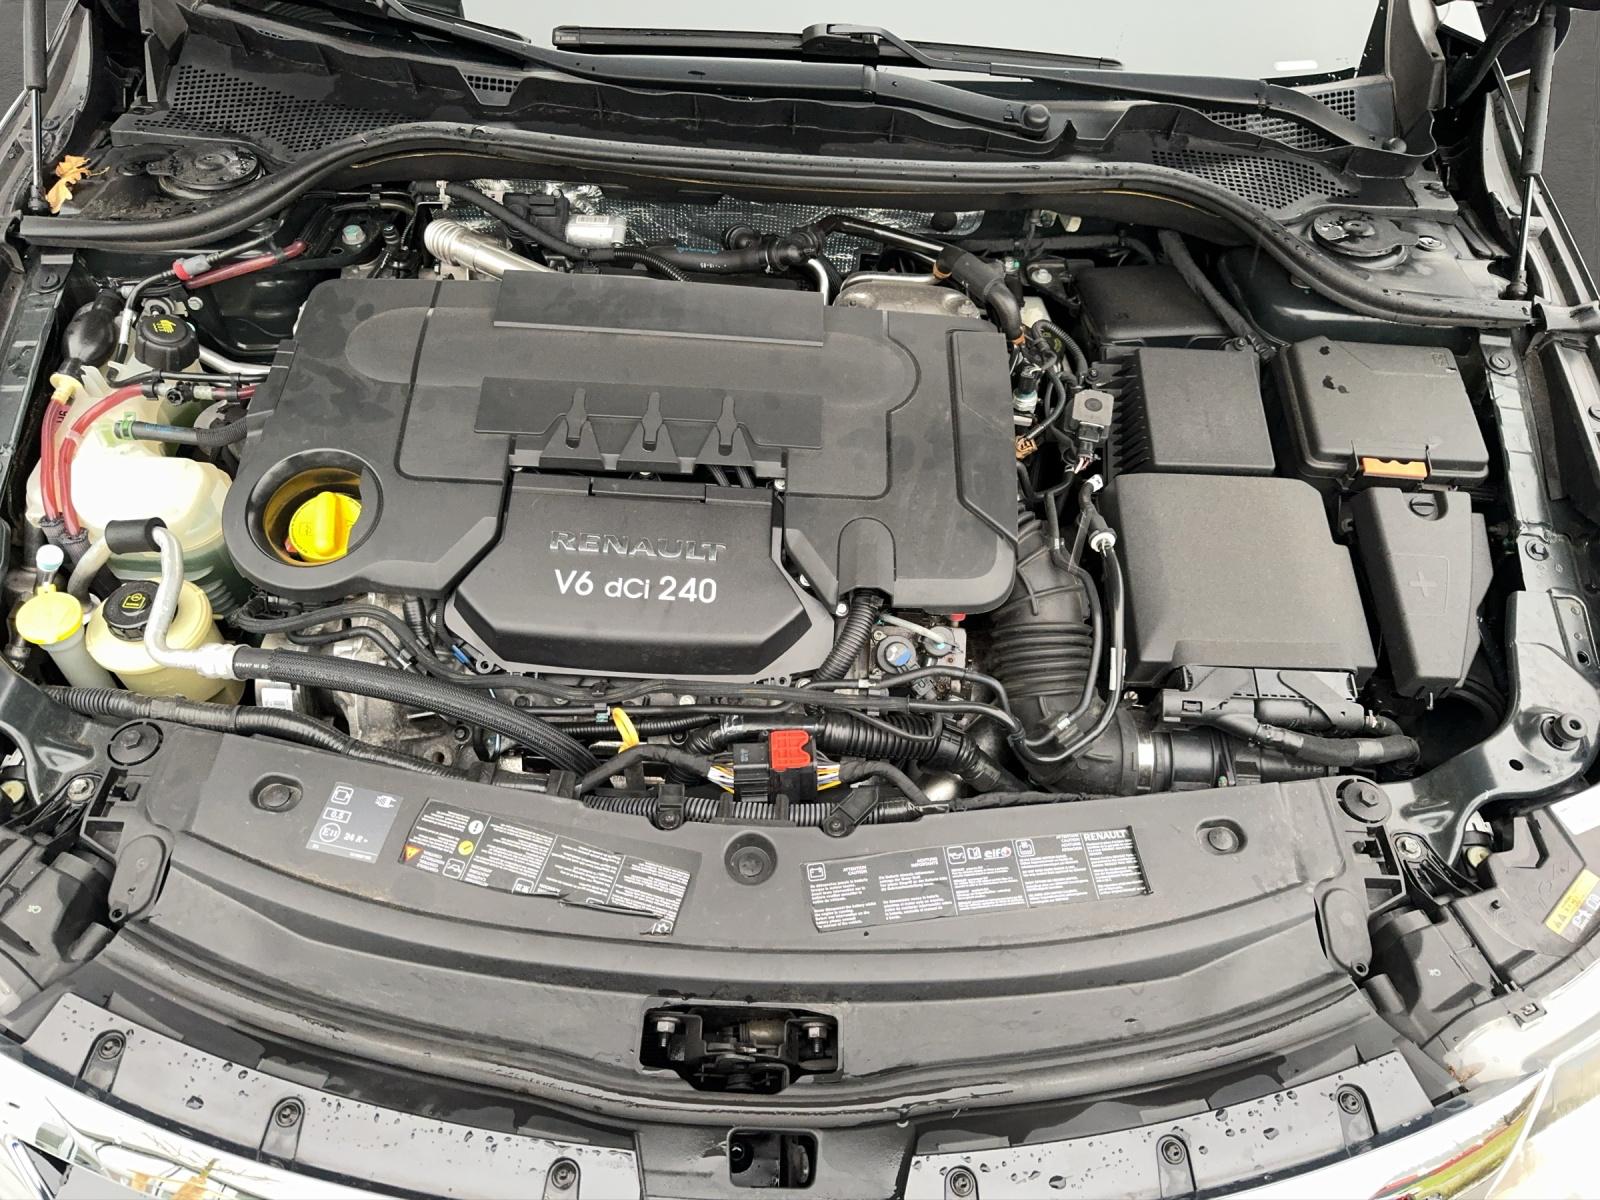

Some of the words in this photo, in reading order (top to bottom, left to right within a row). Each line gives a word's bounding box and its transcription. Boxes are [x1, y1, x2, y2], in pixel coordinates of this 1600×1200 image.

[550, 530, 727, 562] RENAULT
[554, 569, 594, 596] V6
[604, 577, 650, 599] dCi
[658, 575, 717, 603] 240
[1083, 829, 1127, 841] RENAULT
[984, 848, 1003, 859] elf
